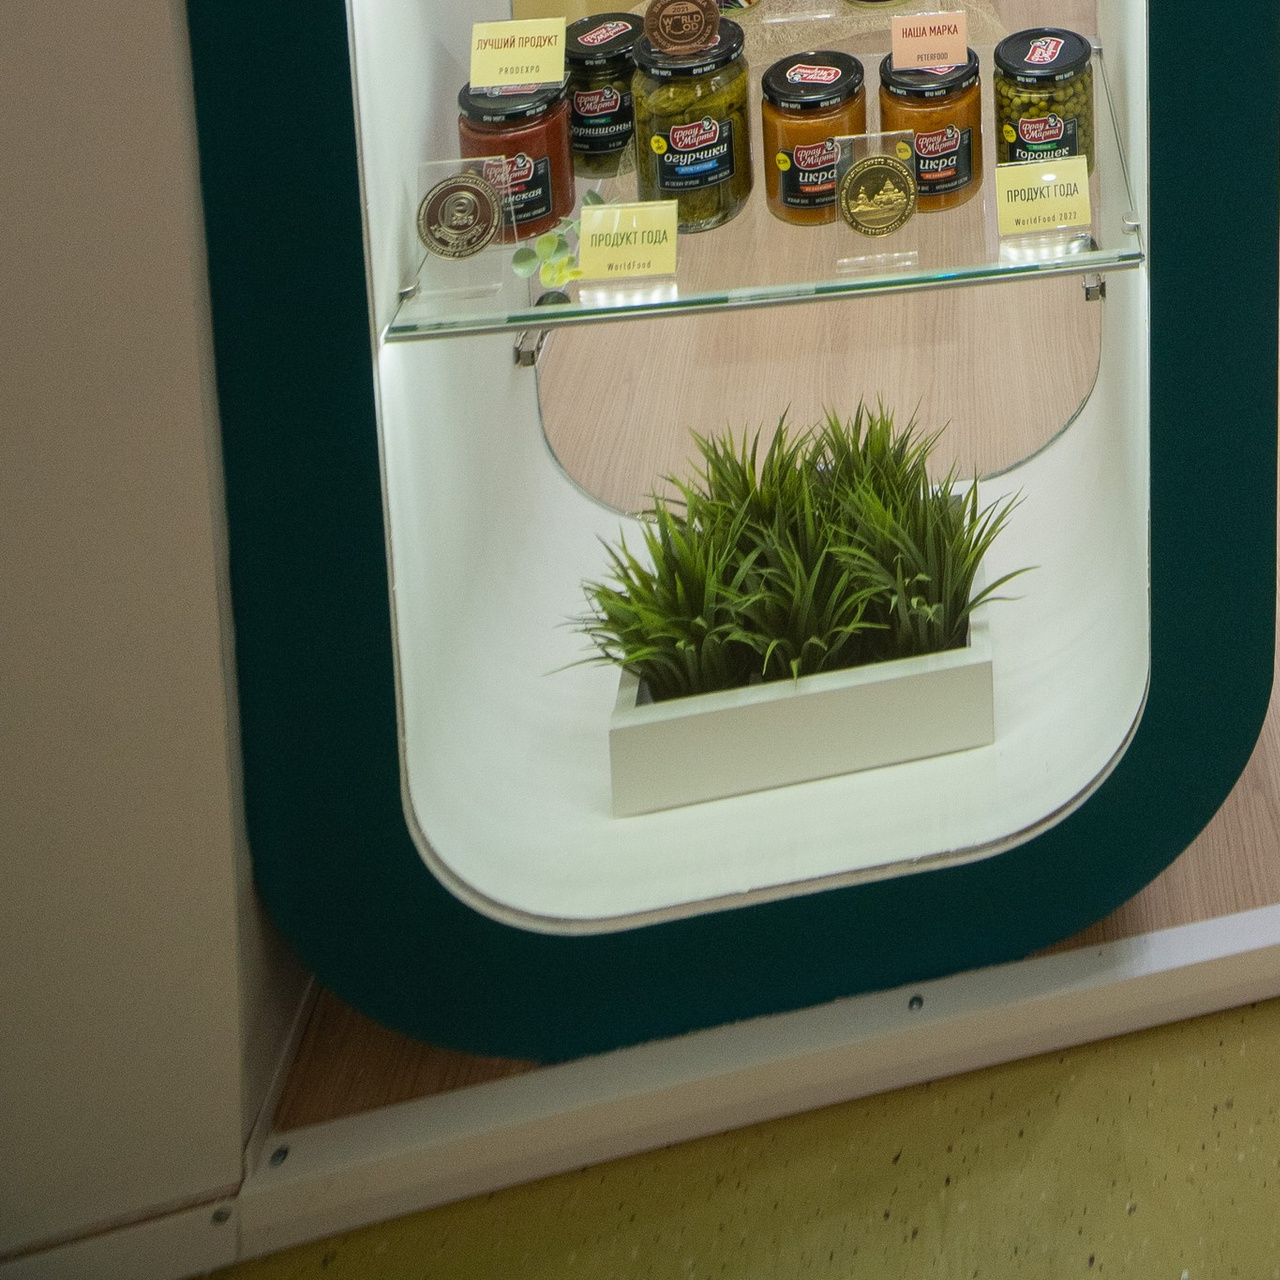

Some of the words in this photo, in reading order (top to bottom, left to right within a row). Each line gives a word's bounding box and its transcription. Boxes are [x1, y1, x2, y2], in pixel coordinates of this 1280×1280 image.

[902, 26, 927, 38] НАША
[929, 24, 959, 37] МАРКА
[477, 35, 515, 50] ЛУЧШИЙ
[518, 35, 558, 48] ПРОДУКТ
[917, 52, 948, 62] PETERFOOD
[499, 65, 540, 74] PRODEXPO
[581, 99, 615, 112] Марта
[679, 131, 714, 147] Марта
[1025, 129, 1059, 139] Марта
[922, 140, 956, 154] Марта
[1007, 185, 1051, 203] ПРОДУКТ
[1054, 182, 1079, 200] ГОДА
[1015, 214, 1056, 227] WorldFood
[1059, 211, 1077, 221] 2022
[591, 232, 638, 247] ПРОДУКТ
[641, 230, 668, 245] ГОДА
[607, 260, 651, 271] WorldFood
